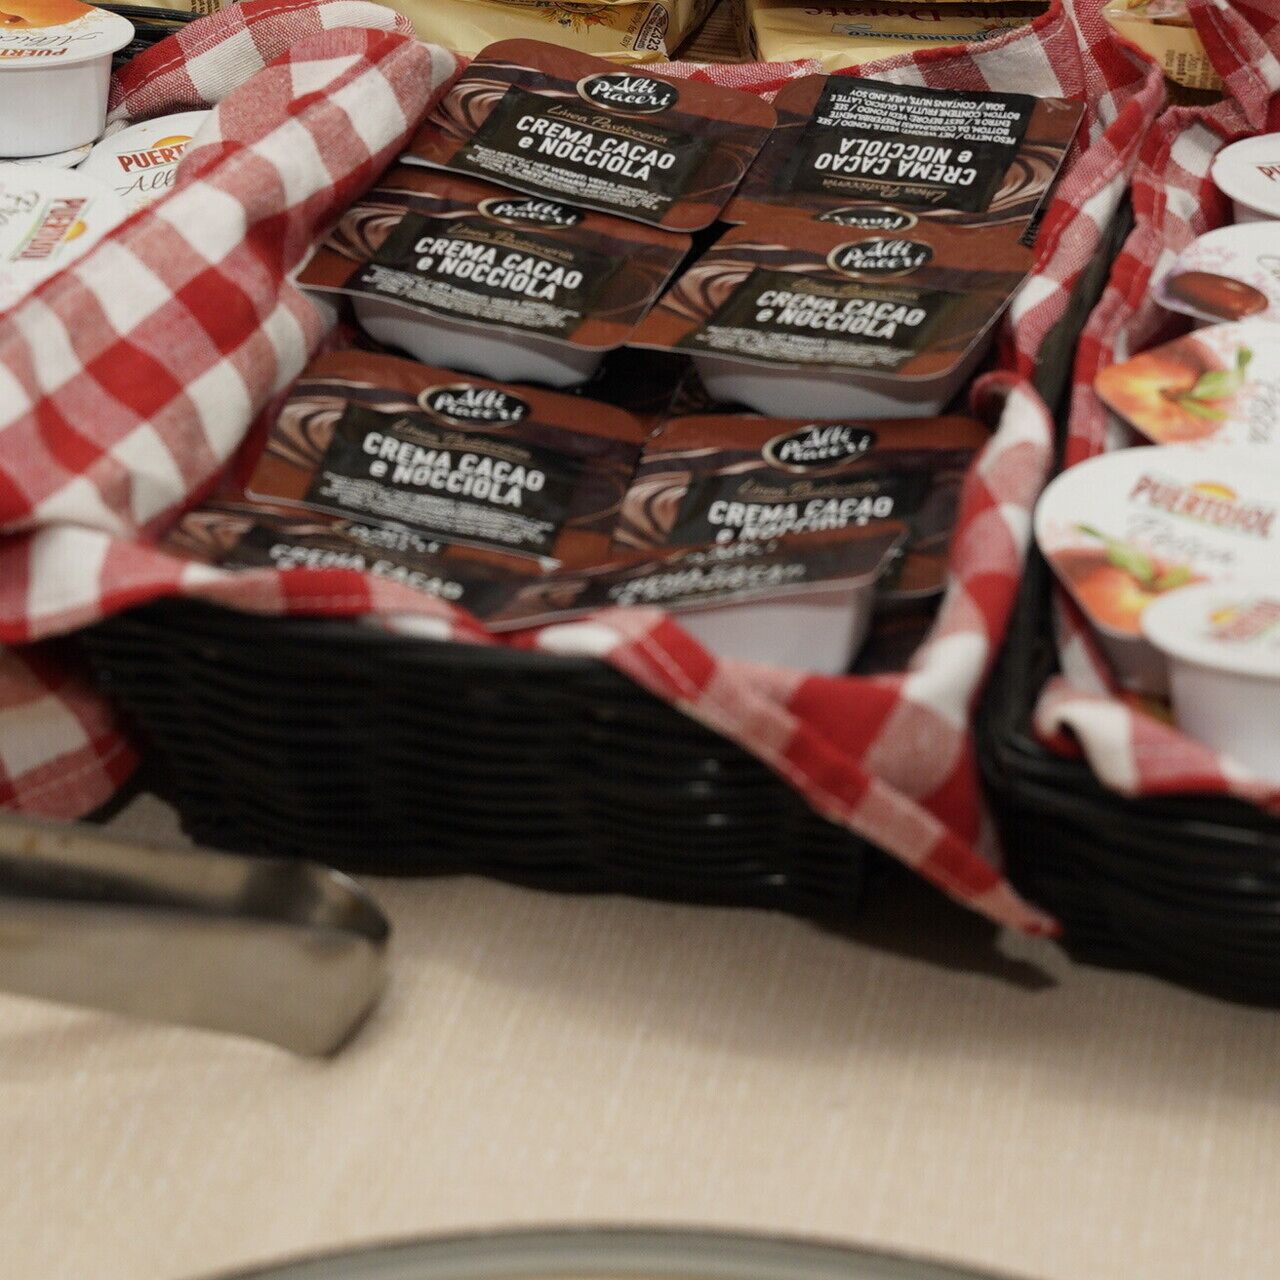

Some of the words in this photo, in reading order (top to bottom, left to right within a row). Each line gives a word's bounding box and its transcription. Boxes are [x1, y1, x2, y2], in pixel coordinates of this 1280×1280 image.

[591, 81, 671, 106] Piaceri
[612, 77, 657, 94] Alti
[849, 90, 869, 99] SOY
[869, 91, 888, 101] AND
[888, 94, 909, 102] MILK
[857, 106, 888, 117] FONDO
[934, 99, 977, 109] CONTAINS
[840, 120, 872, 130] FONDO
[963, 133, 993, 142] NETTO
[516, 115, 594, 148] CREMA
[599, 138, 676, 170] CACAO
[839, 138, 951, 164] NOCCIOLA
[518, 135, 534, 148] e
[538, 137, 652, 182] NOCCIOLA
[814, 152, 890, 176] CACAO
[957, 150, 974, 163] e
[897, 161, 977, 186] CREMA
[414, 237, 498, 266] CREMA
[502, 253, 583, 290] CACAO
[416, 257, 434, 271] e
[437, 257, 557, 301] NOCCIOLA
[756, 290, 839, 313] CREMA
[842, 299, 927, 327] CACAO
[776, 307, 897, 339] NOCCIOLA
[362, 431, 452, 470] CREMA
[458, 453, 546, 492] CACAO
[369, 460, 388, 478] e
[392, 466, 522, 508] NOCCIOLA
[707, 499, 798, 525] CREMA
[805, 496, 894, 519] CACAO
